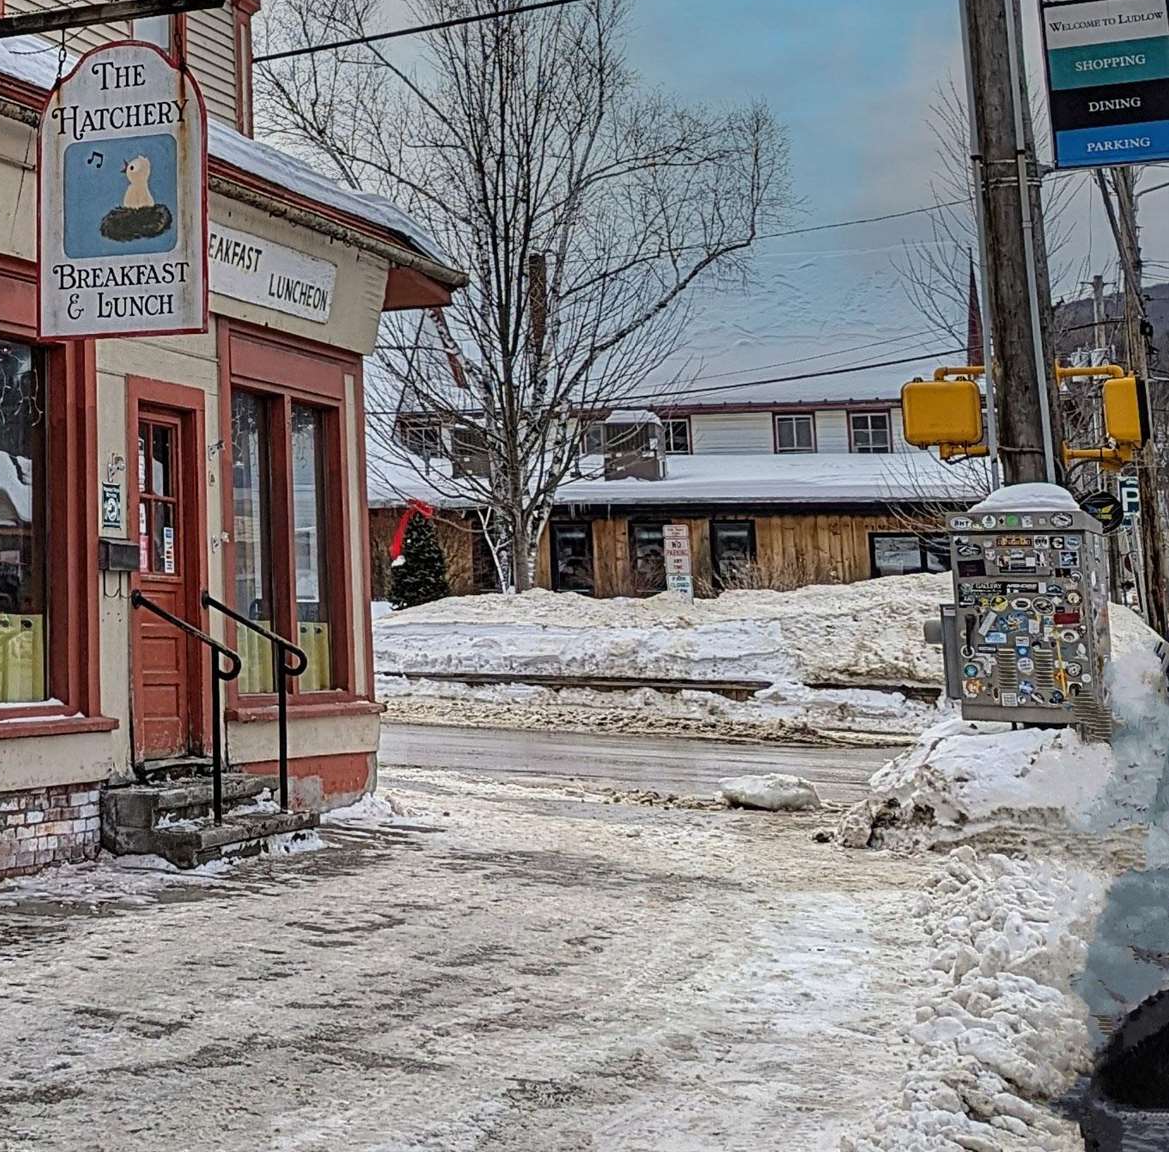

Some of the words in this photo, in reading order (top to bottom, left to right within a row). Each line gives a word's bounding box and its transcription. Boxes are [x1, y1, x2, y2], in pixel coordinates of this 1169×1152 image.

[1049, 20, 1101, 33] WELCOME
[1103, 18, 1116, 27] TO
[1118, 11, 1164, 25] LUDLOW
[91, 62, 146, 91] THE
[1075, 54, 1146, 72] SHOPPING
[1088, 97, 1142, 113] DINING
[51, 99, 189, 140] HATCHERY
[1087, 137, 1151, 153] PARKING
[208, 233, 262, 273] EAKFAST
[53, 262, 190, 291] BREAKFAST
[67, 294, 85, 320] &
[97, 293, 175, 319] LUNCH
[268, 273, 329, 312] LUNCHEON
